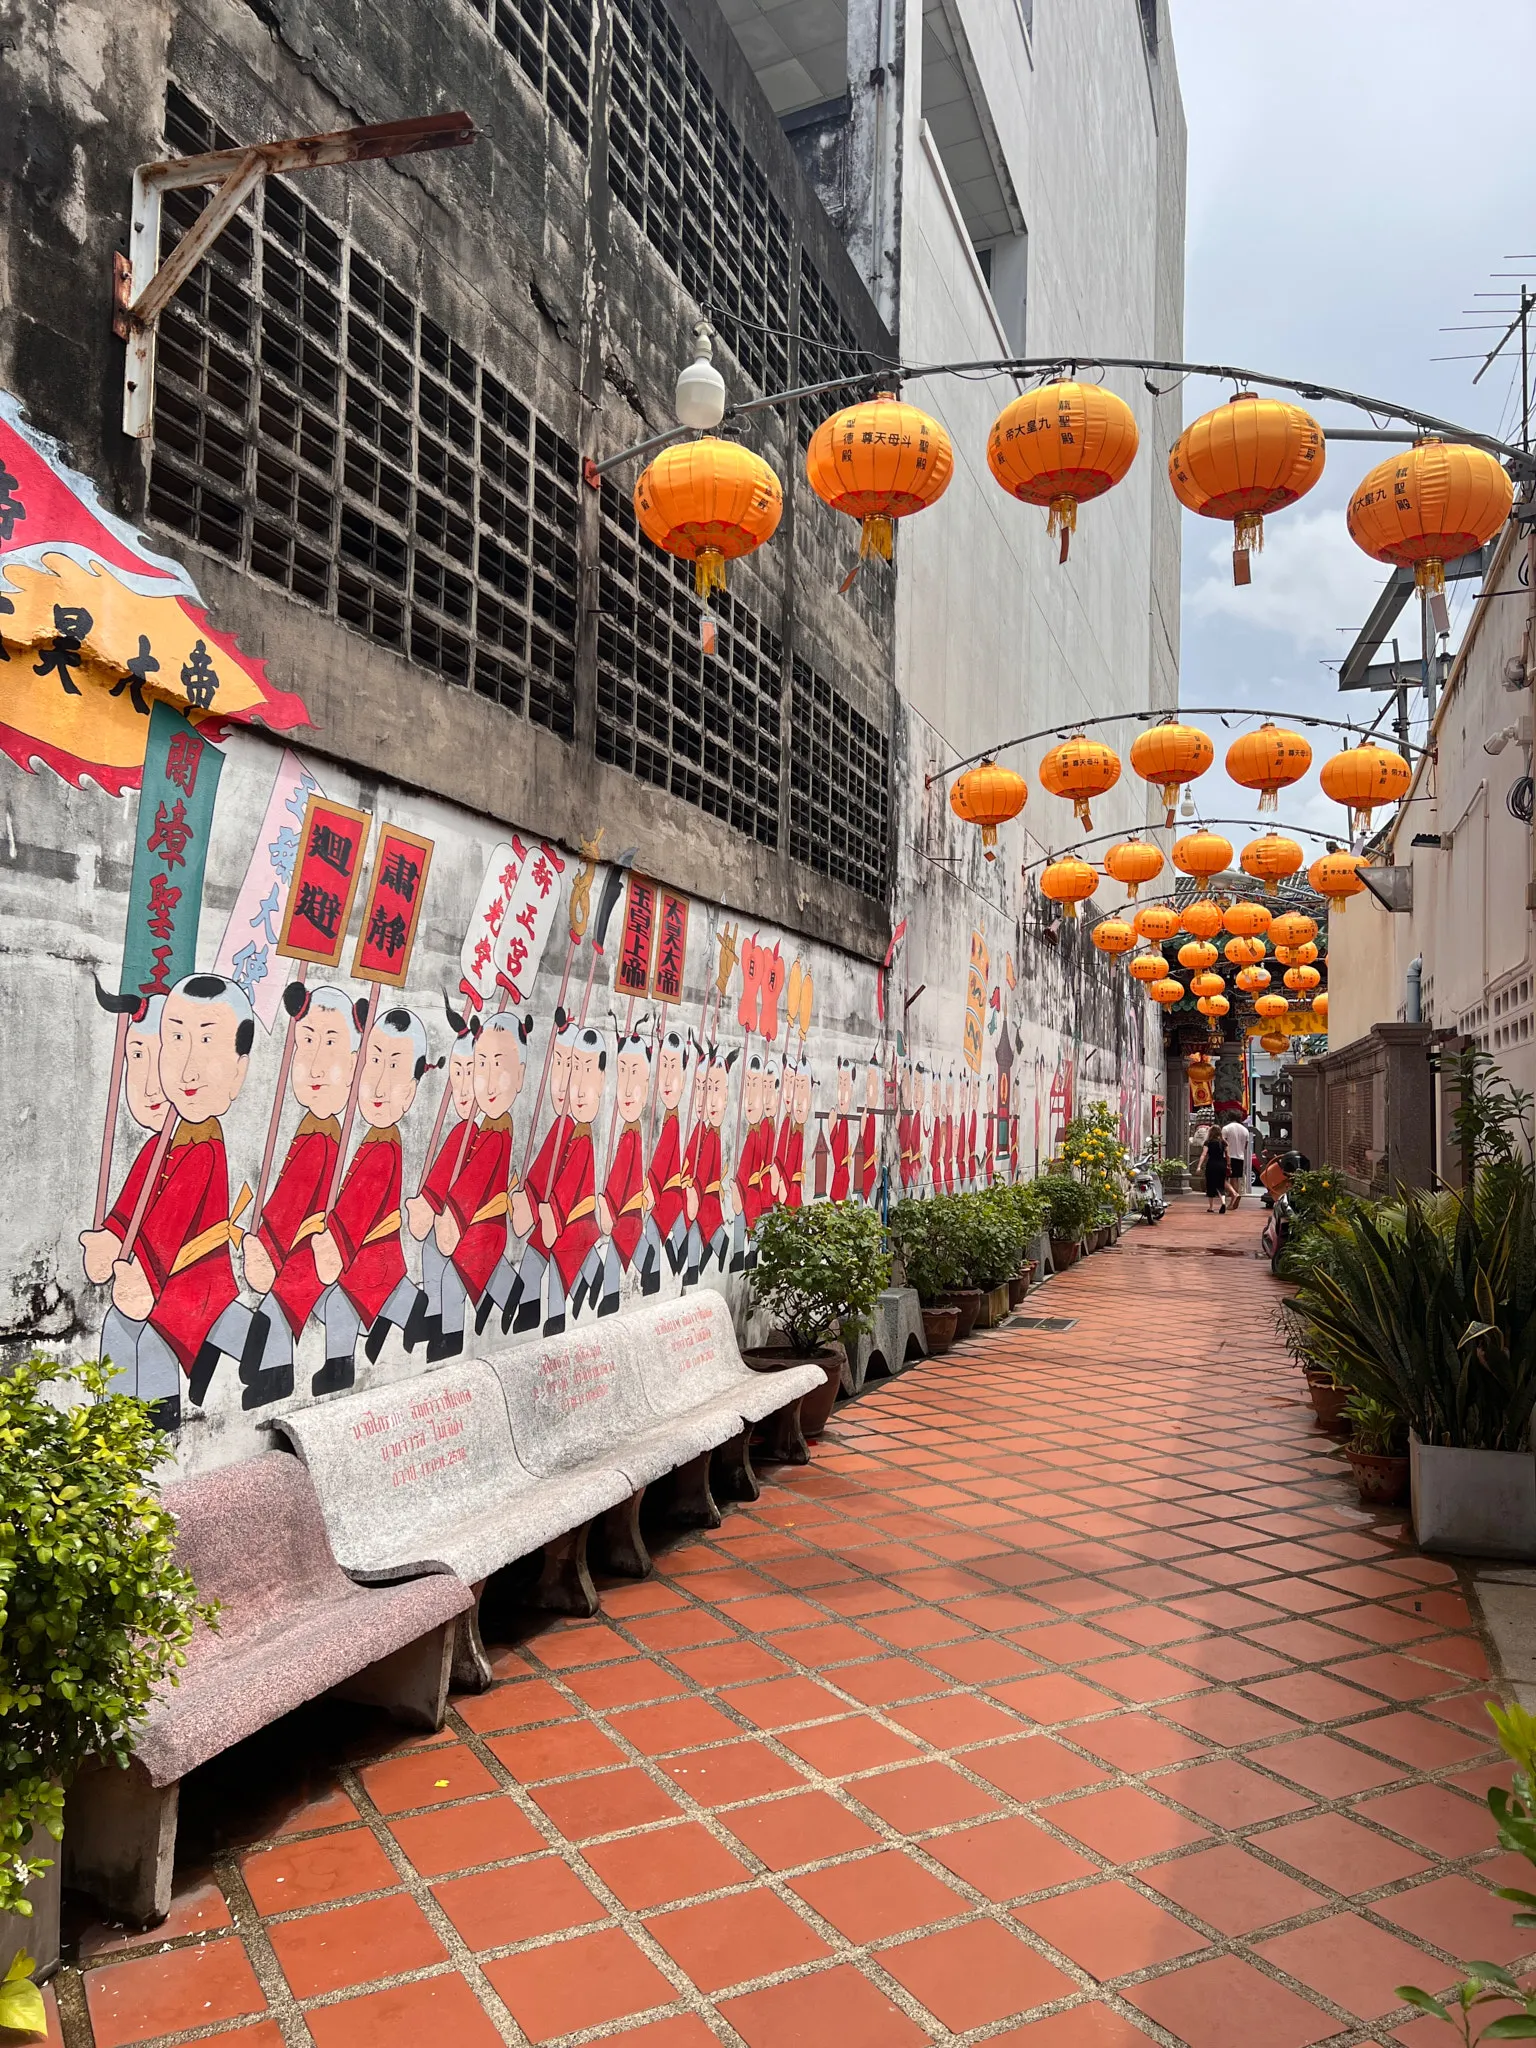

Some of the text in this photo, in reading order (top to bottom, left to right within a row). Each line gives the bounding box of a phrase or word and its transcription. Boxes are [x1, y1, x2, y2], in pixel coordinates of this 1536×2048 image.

[622, 882, 652, 988] 玉皇上帝
[657, 899, 682, 995] 太昊大帝
